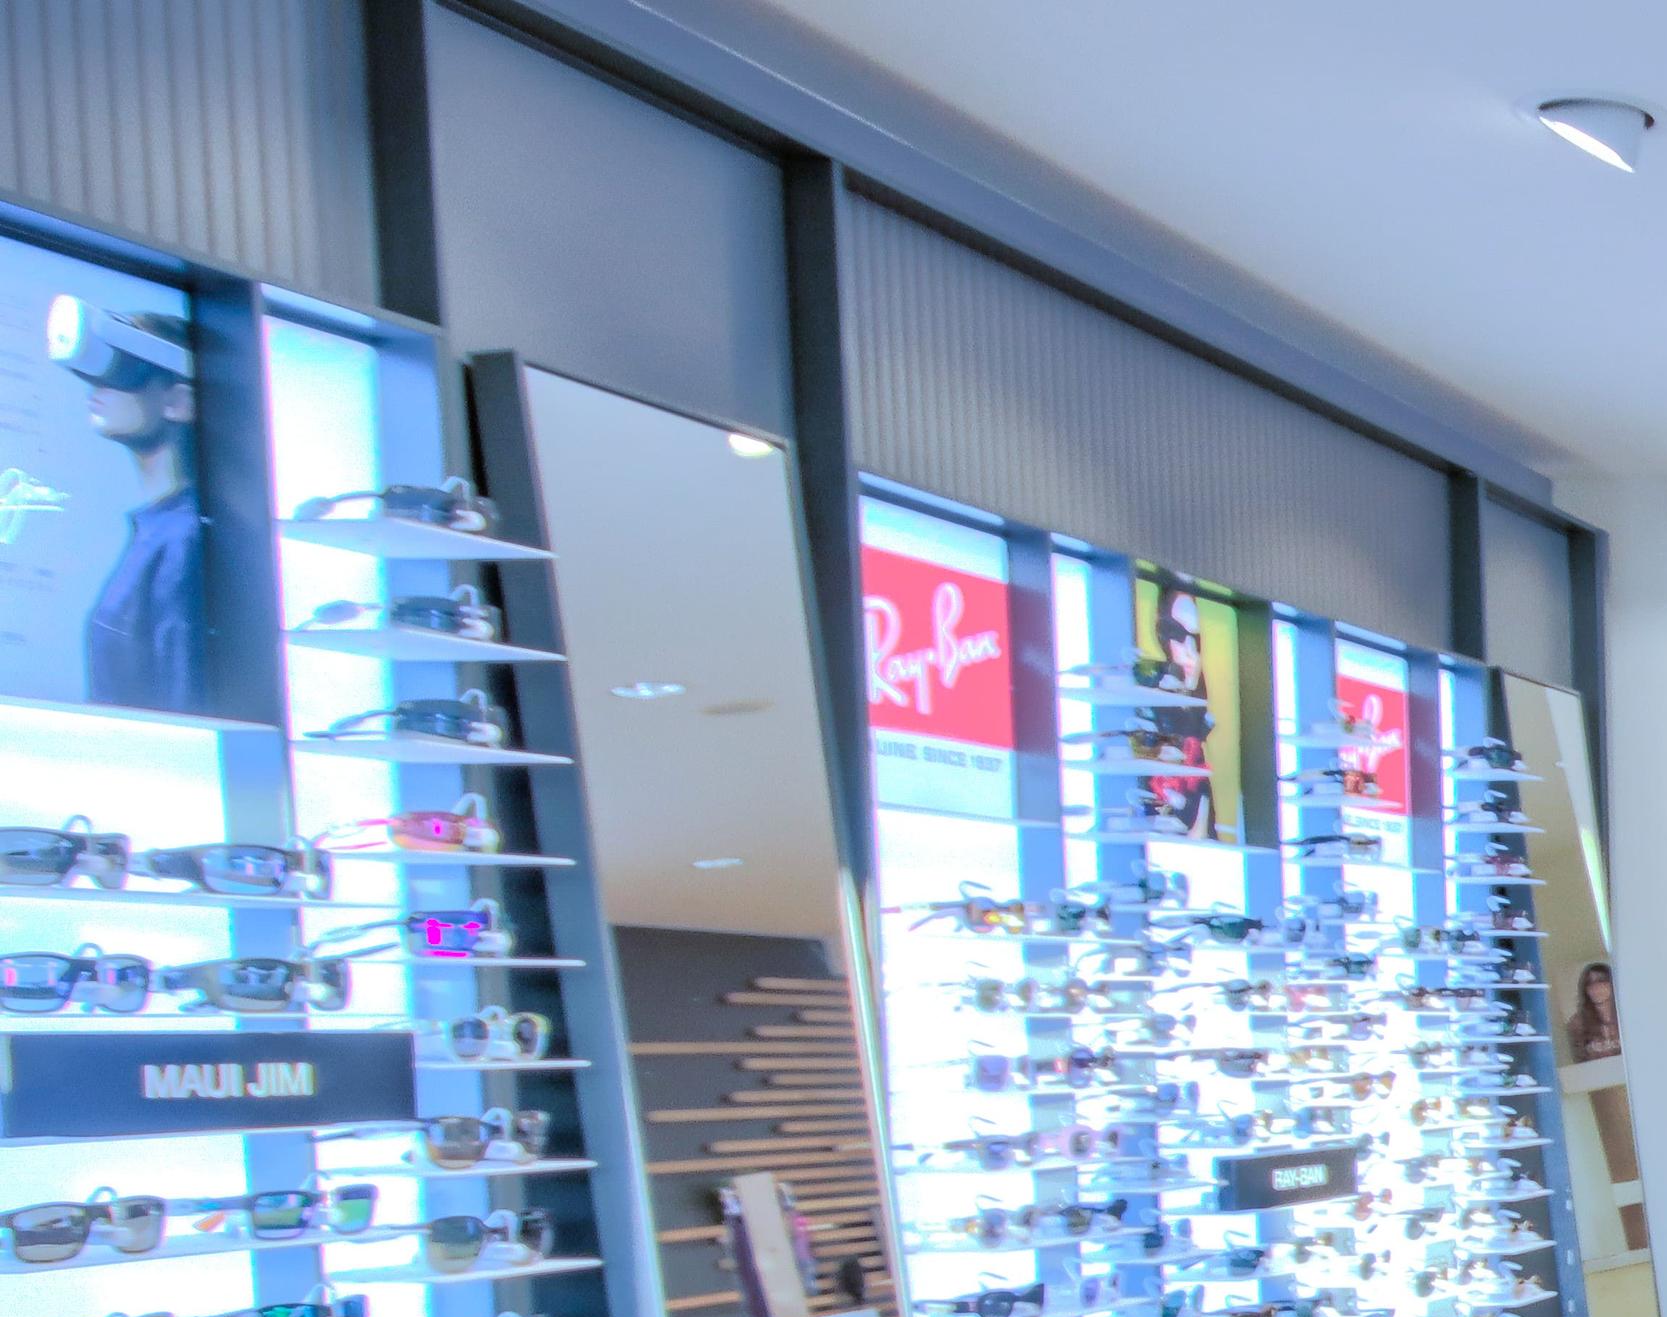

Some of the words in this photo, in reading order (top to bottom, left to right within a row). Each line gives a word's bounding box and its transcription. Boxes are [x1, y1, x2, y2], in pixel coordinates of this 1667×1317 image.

[143, 1063, 244, 1098] MAUI
[246, 1061, 315, 1098] JIM
[1271, 1164, 1329, 1191] RAY-BAN
